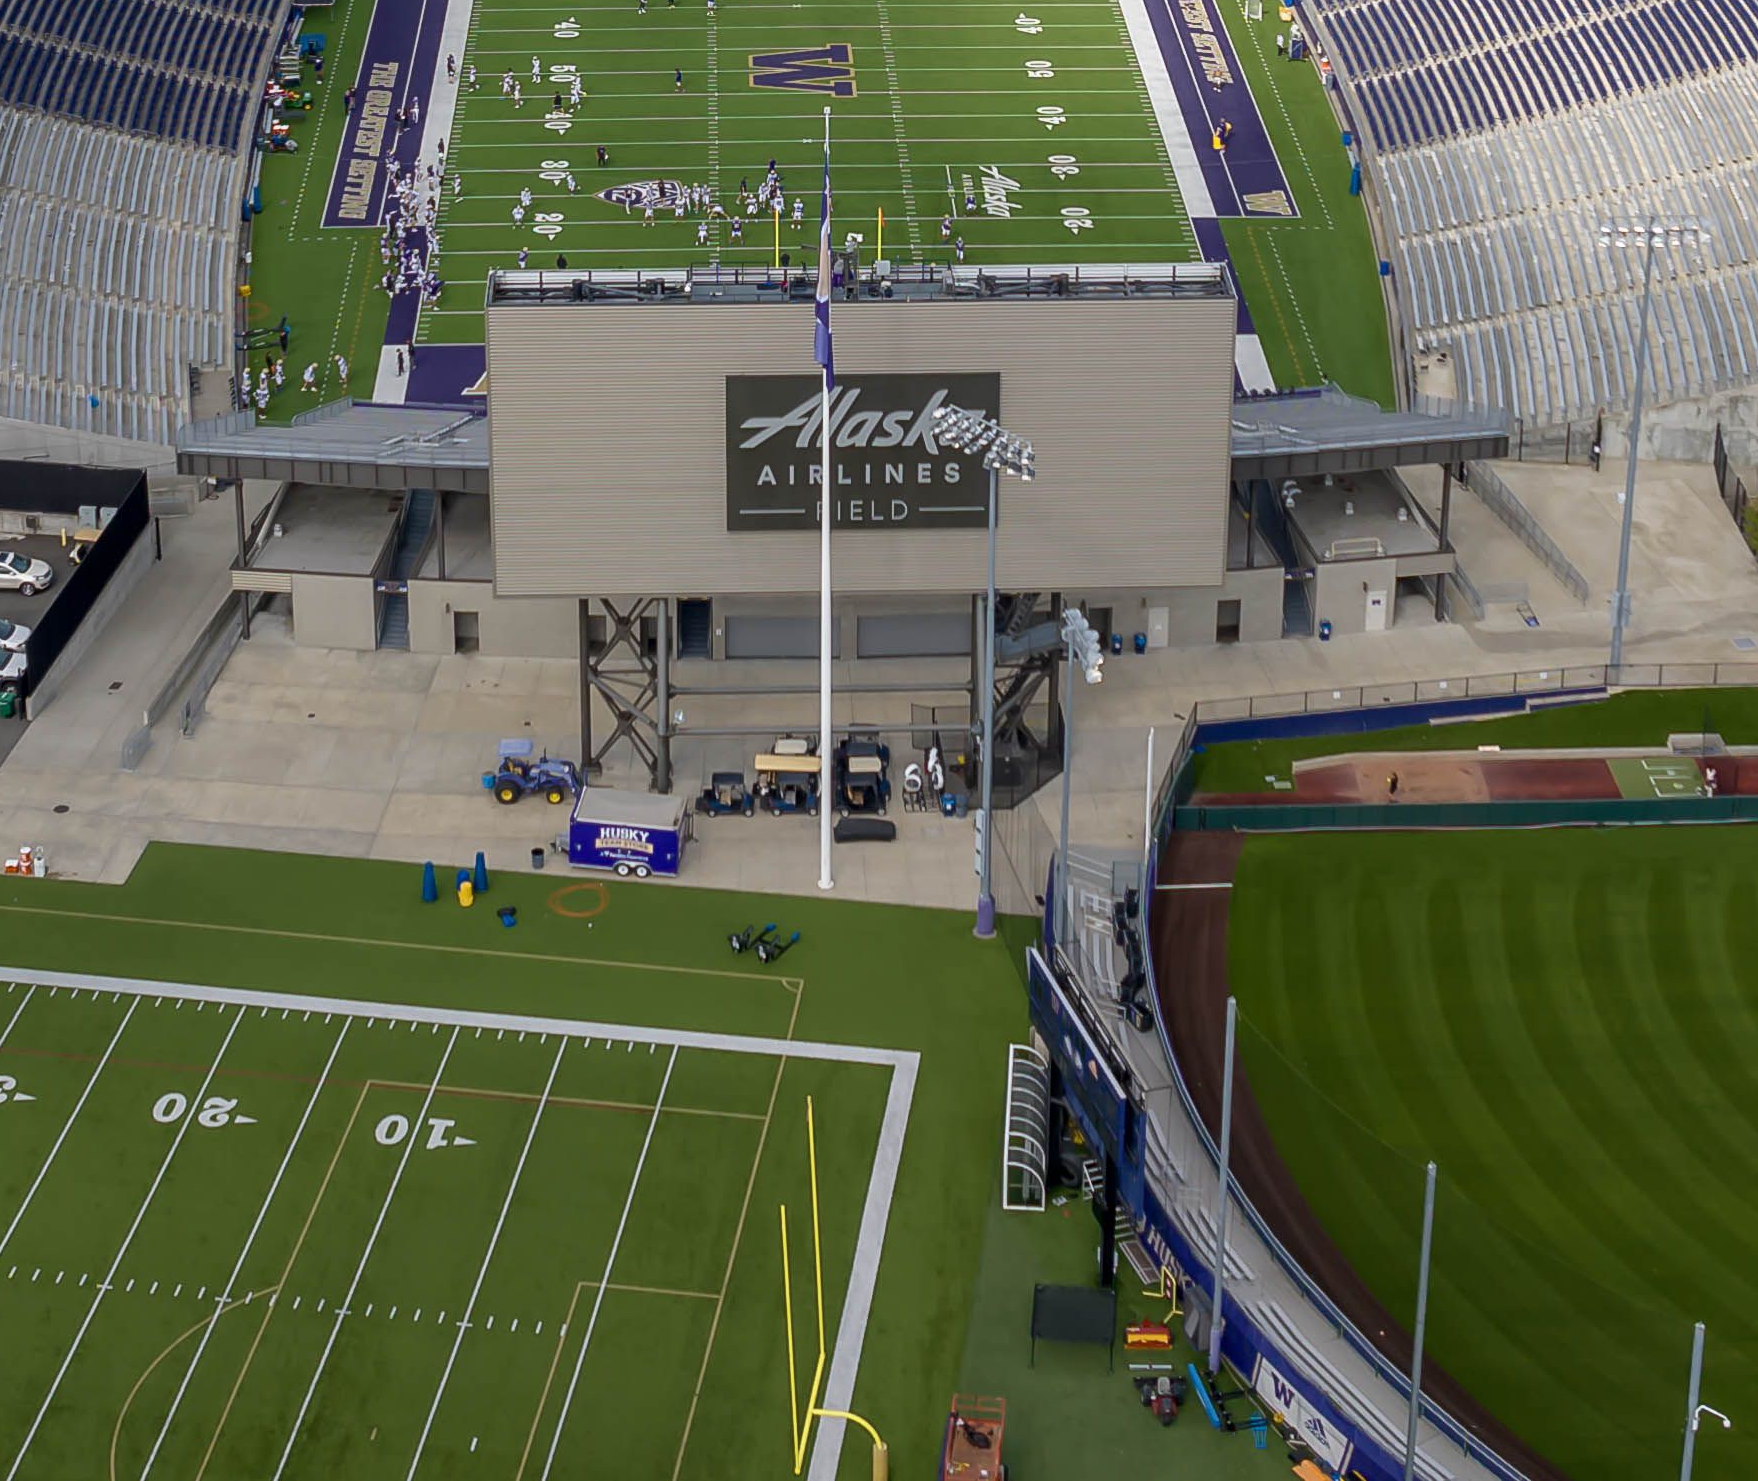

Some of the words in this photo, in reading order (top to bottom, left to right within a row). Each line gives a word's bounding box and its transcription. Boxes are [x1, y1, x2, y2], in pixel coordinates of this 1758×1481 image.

[368, 62, 399, 88] THE
[549, 65, 577, 82] 50
[747, 42, 858, 98] W
[1025, 60, 1055, 78] 50
[1243, 190, 1293, 216] W
[739, 385, 986, 455] Alask
[757, 462, 960, 486] AIRLINES
[600, 827, 650, 843] HUSKY
[152, 1092, 238, 1128] 20
[374, 1114, 456, 1151] 10
[1271, 1371, 1296, 1409] W
